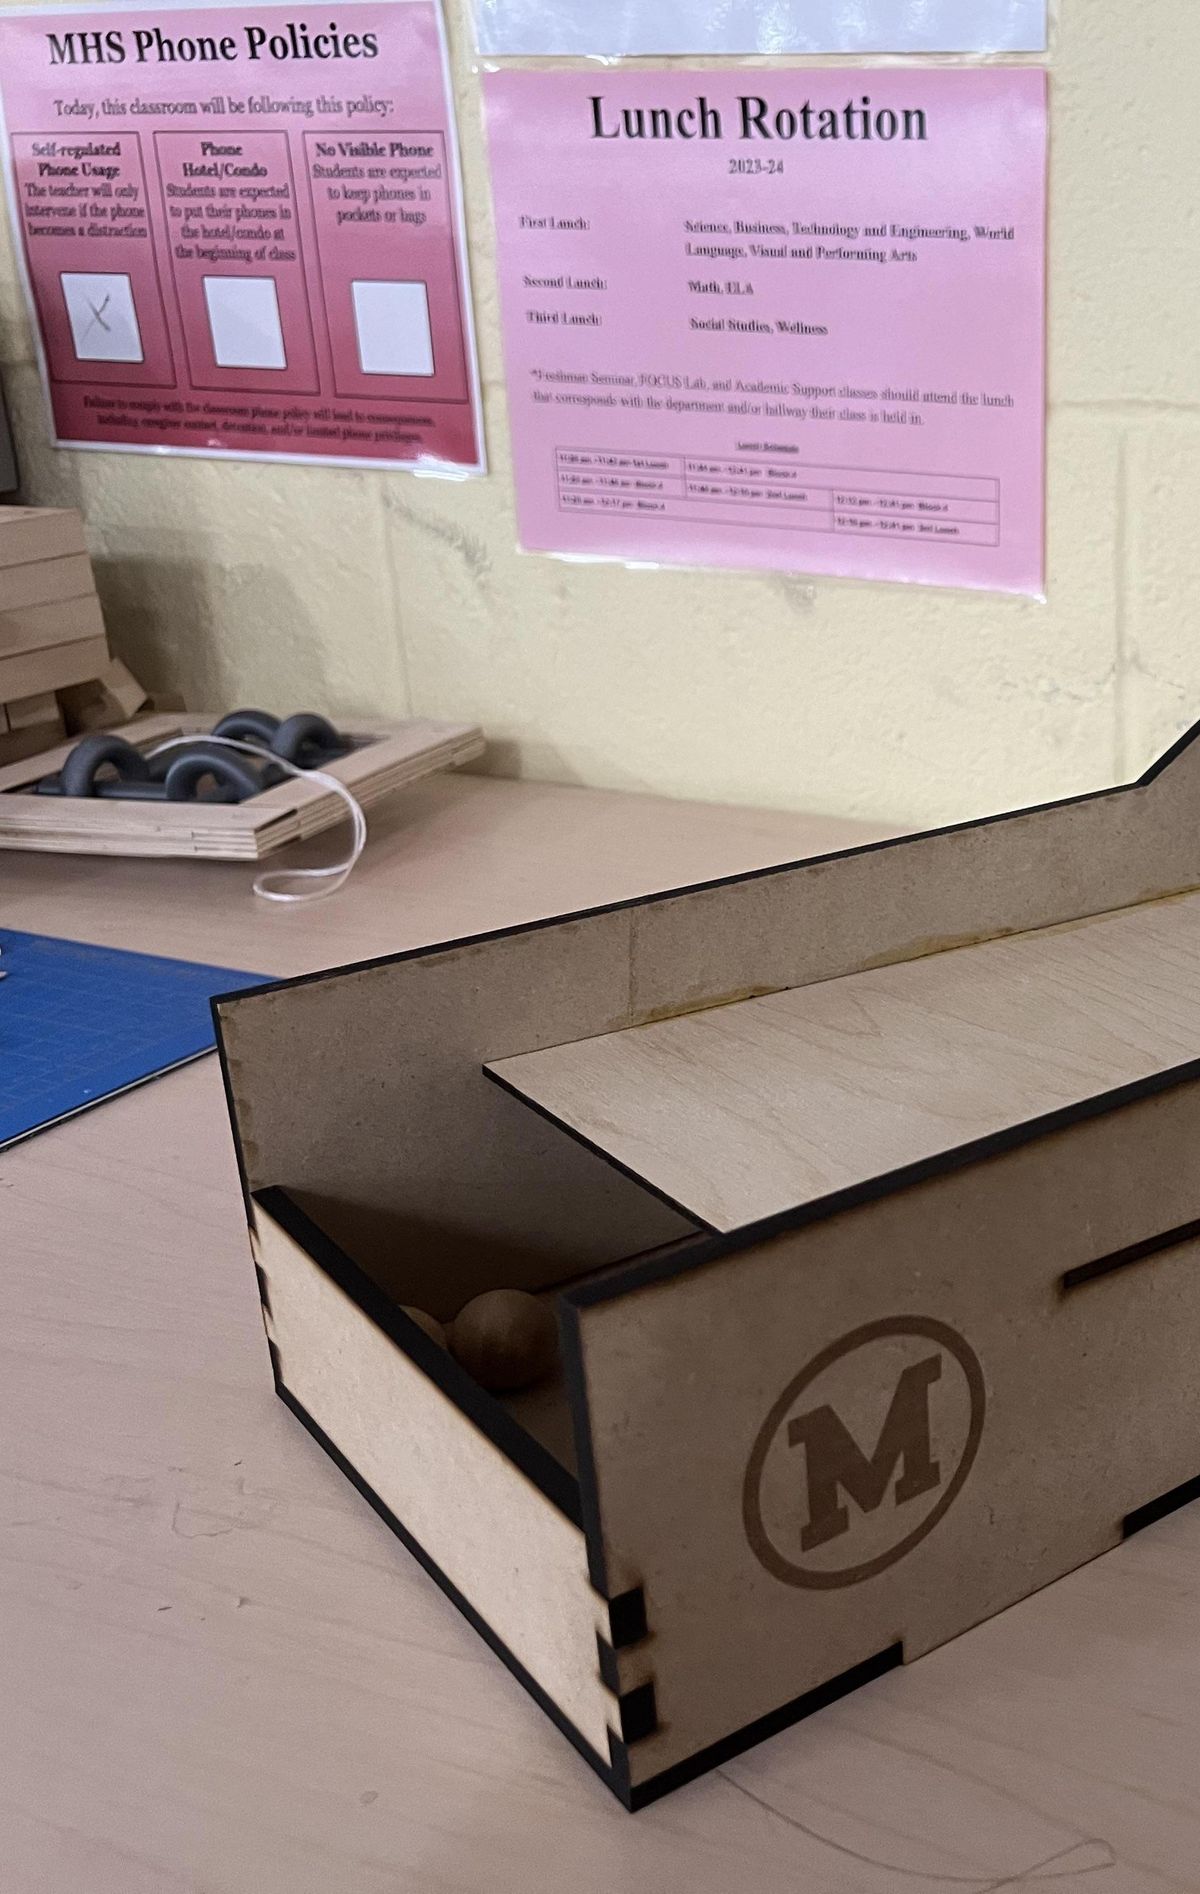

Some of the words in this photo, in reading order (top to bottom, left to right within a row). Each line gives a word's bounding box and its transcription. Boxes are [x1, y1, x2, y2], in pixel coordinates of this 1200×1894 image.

[46, 31, 126, 65] MHS
[132, 27, 238, 62] Phone
[244, 22, 379, 60] Policies
[53, 99, 99, 119] Today,
[102, 98, 126, 115] this
[130, 98, 198, 114] classroom
[201, 96, 225, 114] will
[228, 96, 245, 113] be
[248, 95, 314, 118] following
[316, 95, 343, 113] this
[346, 95, 394, 118] policy:
[588, 95, 723, 140] Lunch
[735, 95, 928, 141] Rotation
[32, 142, 121, 159] Self-regulated
[200, 142, 243, 156] Phone
[316, 142, 336, 157] No
[338, 141, 386, 157] Visible
[389, 142, 434, 157] Phone
[38, 162, 79, 176] Phone
[81, 162, 120, 179] Usage
[183, 162, 268, 180] Hotel/Condo
[312, 163, 365, 179] Students
[367, 167, 387, 179] are
[389, 163, 442, 182] expected
[728, 158, 784, 175] 2023-24
[25, 183, 46, 197] The
[48, 183, 89, 197] teacher
[91, 183, 112, 197] will
[114, 183, 139, 201] only
[166, 183, 216, 197] Students
[219, 186, 237, 197] are
[239, 183, 289, 201] expected
[327, 187, 340, 200] to
[341, 184, 371, 204] keep
[373, 184, 416, 204] phones
[418, 185, 431, 201] in
[78, 203, 87, 217] if
[90, 203, 107, 217] the
[110, 203, 144, 221] phone
[170, 206, 182, 217] to
[184, 206, 203, 221] put
[205, 203, 232, 218] their
[235, 204, 277, 222] phones
[279, 204, 291, 219] in
[336, 207, 381, 226] pockets
[384, 211, 397, 222] or
[400, 207, 427, 227] bags
[78, 227, 85, 236] a
[87, 222, 147, 237] distraction
[520, 215, 547, 229] First
[549, 216, 590, 230] Lunch:
[684, 220, 732, 234] Science,
[734, 221, 789, 235] Business,
[792, 222, 860, 240] Technology
[864, 224, 887, 238] and
[889, 224, 970, 242] Engineering,
[973, 225, 1015, 240] World
[181, 224, 199, 238] the
[201, 224, 271, 241] hotel/condo
[273, 229, 285, 240] at
[175, 244, 193, 258] the
[195, 244, 253, 263] beginning
[255, 245, 267, 260] of
[268, 245, 296, 260] class
[685, 243, 748, 259] Language,
[749, 244, 787, 258] Visual
[791, 245, 813, 259] and
[815, 246, 887, 263] Performing
[890, 249, 918, 262] Arts
[522, 274, 564, 288] Second
[566, 275, 608, 290] Lunch:
[688, 280, 724, 294] Math,
[725, 281, 755, 295] ELA
[526, 310, 559, 324] Third
[690, 318, 725, 331] Social
[727, 318, 774, 334] Studies,
[775, 320, 829, 335] Wellness
[712, 379, 732, 391] and
[735, 379, 790, 395] Academic
[792, 382, 837, 400] Support
[839, 385, 878, 400] classes
[881, 385, 920, 402] should
[923, 390, 958, 405] attend
[960, 391, 979, 405] the
[981, 393, 1014, 408] lunch
[533, 391, 552, 403] that
[555, 392, 617, 407] corresponds
[621, 395, 642, 408] with
[646, 395, 662, 409] the
[666, 395, 724, 413] department
[727, 400, 762, 416] and/or
[765, 402, 808, 420] hallway
[810, 405, 836, 420] their
[839, 407, 867, 421] class
[870, 410, 879, 421] is
[882, 409, 907, 424] held
[787, 1353, 943, 1553] M
